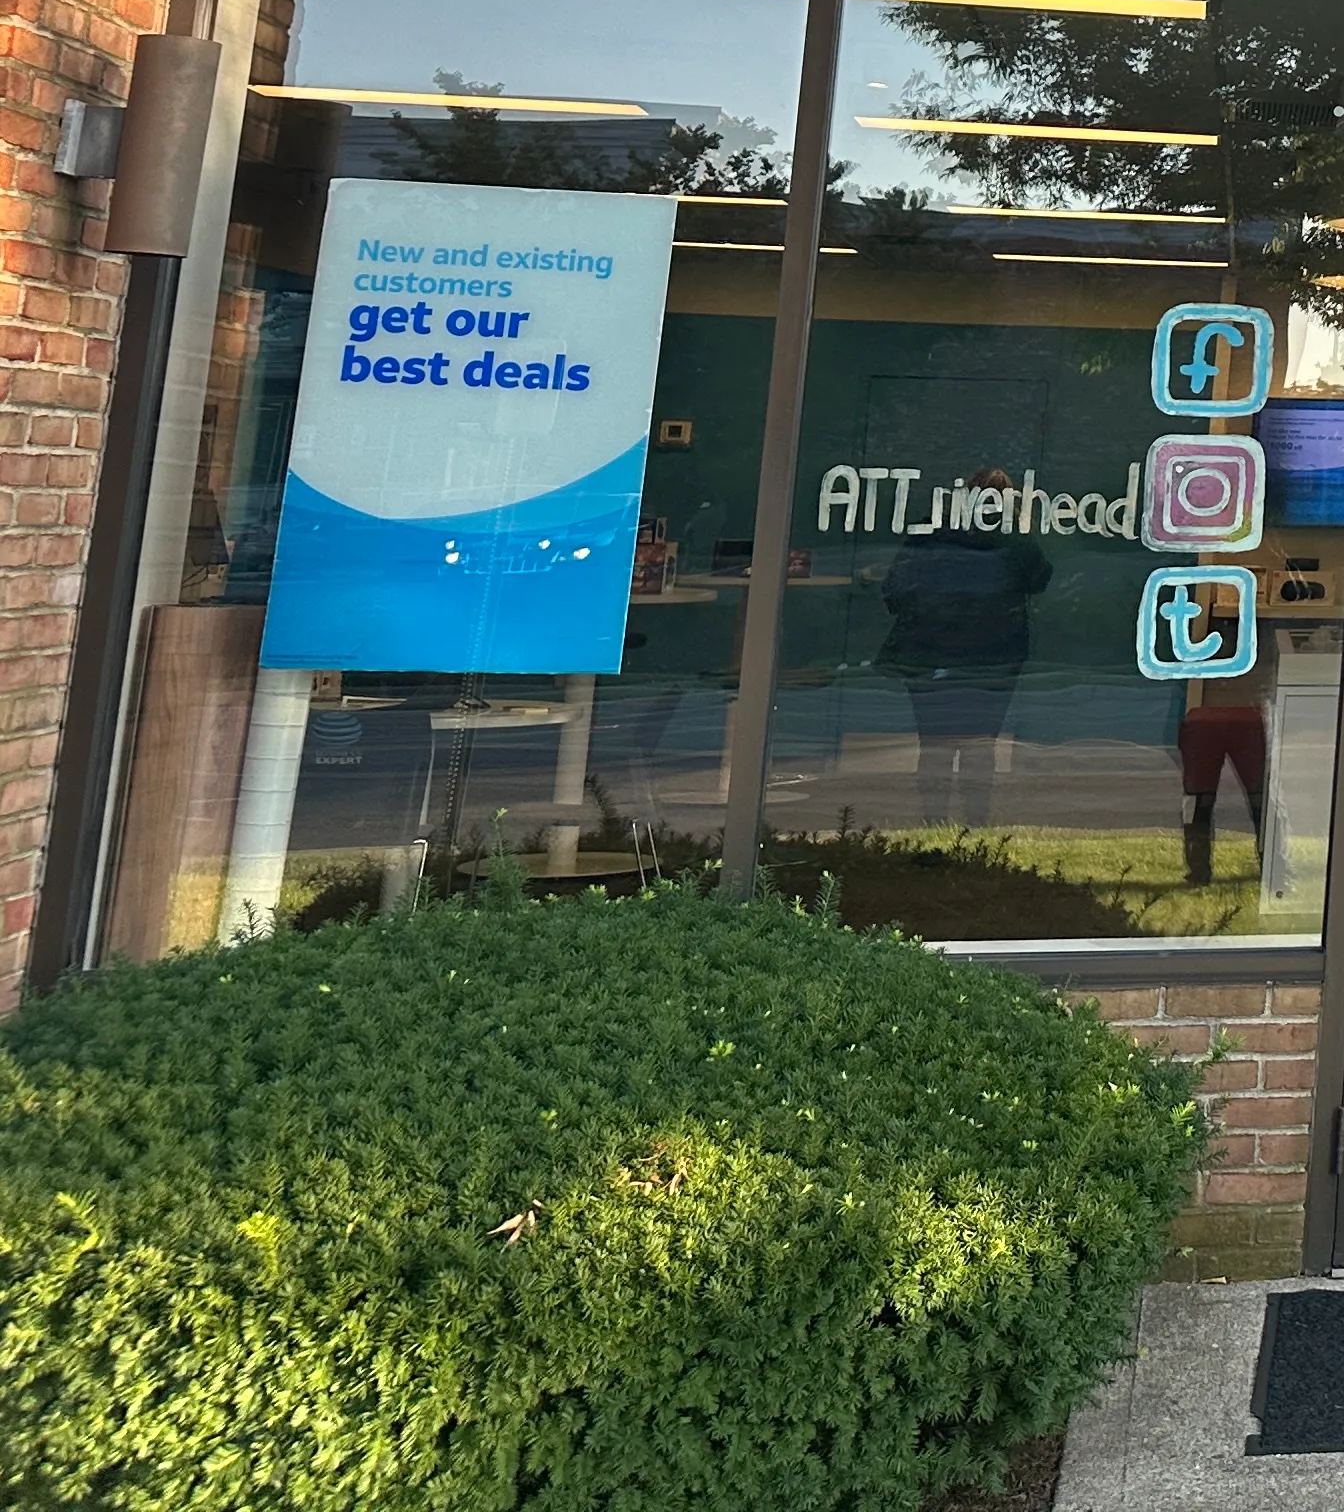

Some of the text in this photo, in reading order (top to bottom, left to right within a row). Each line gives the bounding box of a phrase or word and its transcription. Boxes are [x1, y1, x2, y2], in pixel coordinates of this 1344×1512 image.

[357, 239, 613, 279] New and existing
[353, 272, 513, 298] customers
[349, 301, 530, 342] get our
[340, 345, 591, 391] best deals
